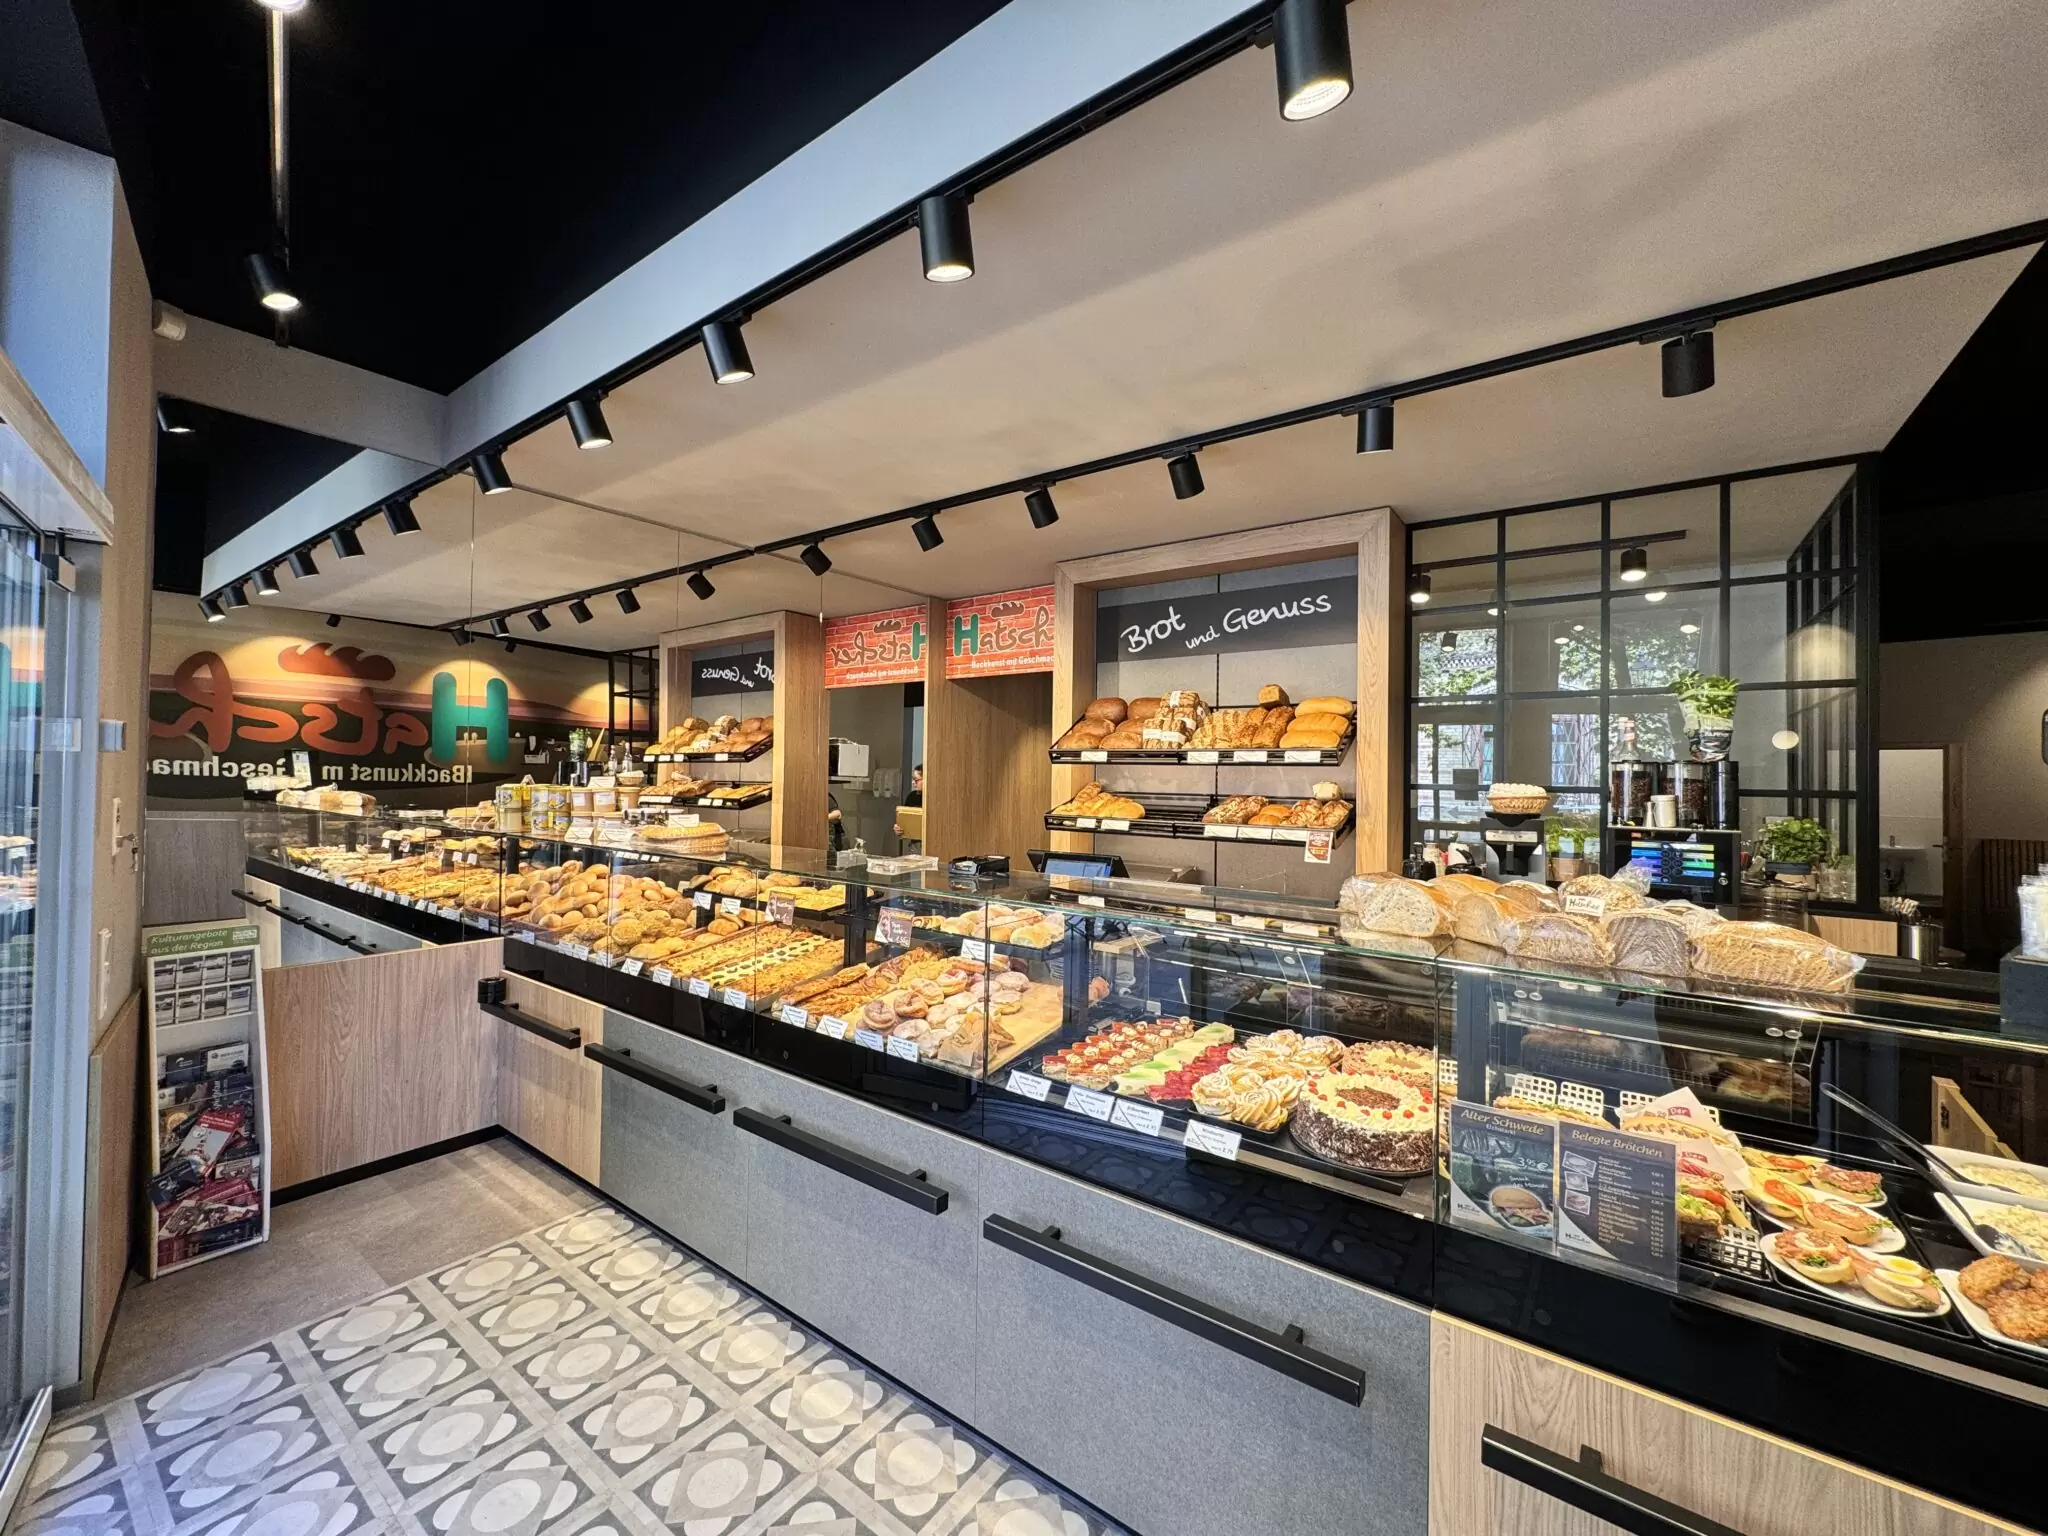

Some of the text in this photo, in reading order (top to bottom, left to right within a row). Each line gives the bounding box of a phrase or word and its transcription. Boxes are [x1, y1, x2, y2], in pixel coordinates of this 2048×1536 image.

[1120, 593, 1332, 653] Brot und Genuss
[151, 929, 228, 944] Kulturangebote
[151, 940, 224, 955] aus der Region
[1461, 1109, 1545, 1136] Alter Schwede
[1571, 1129, 1663, 1158] Belegte Brötchen
